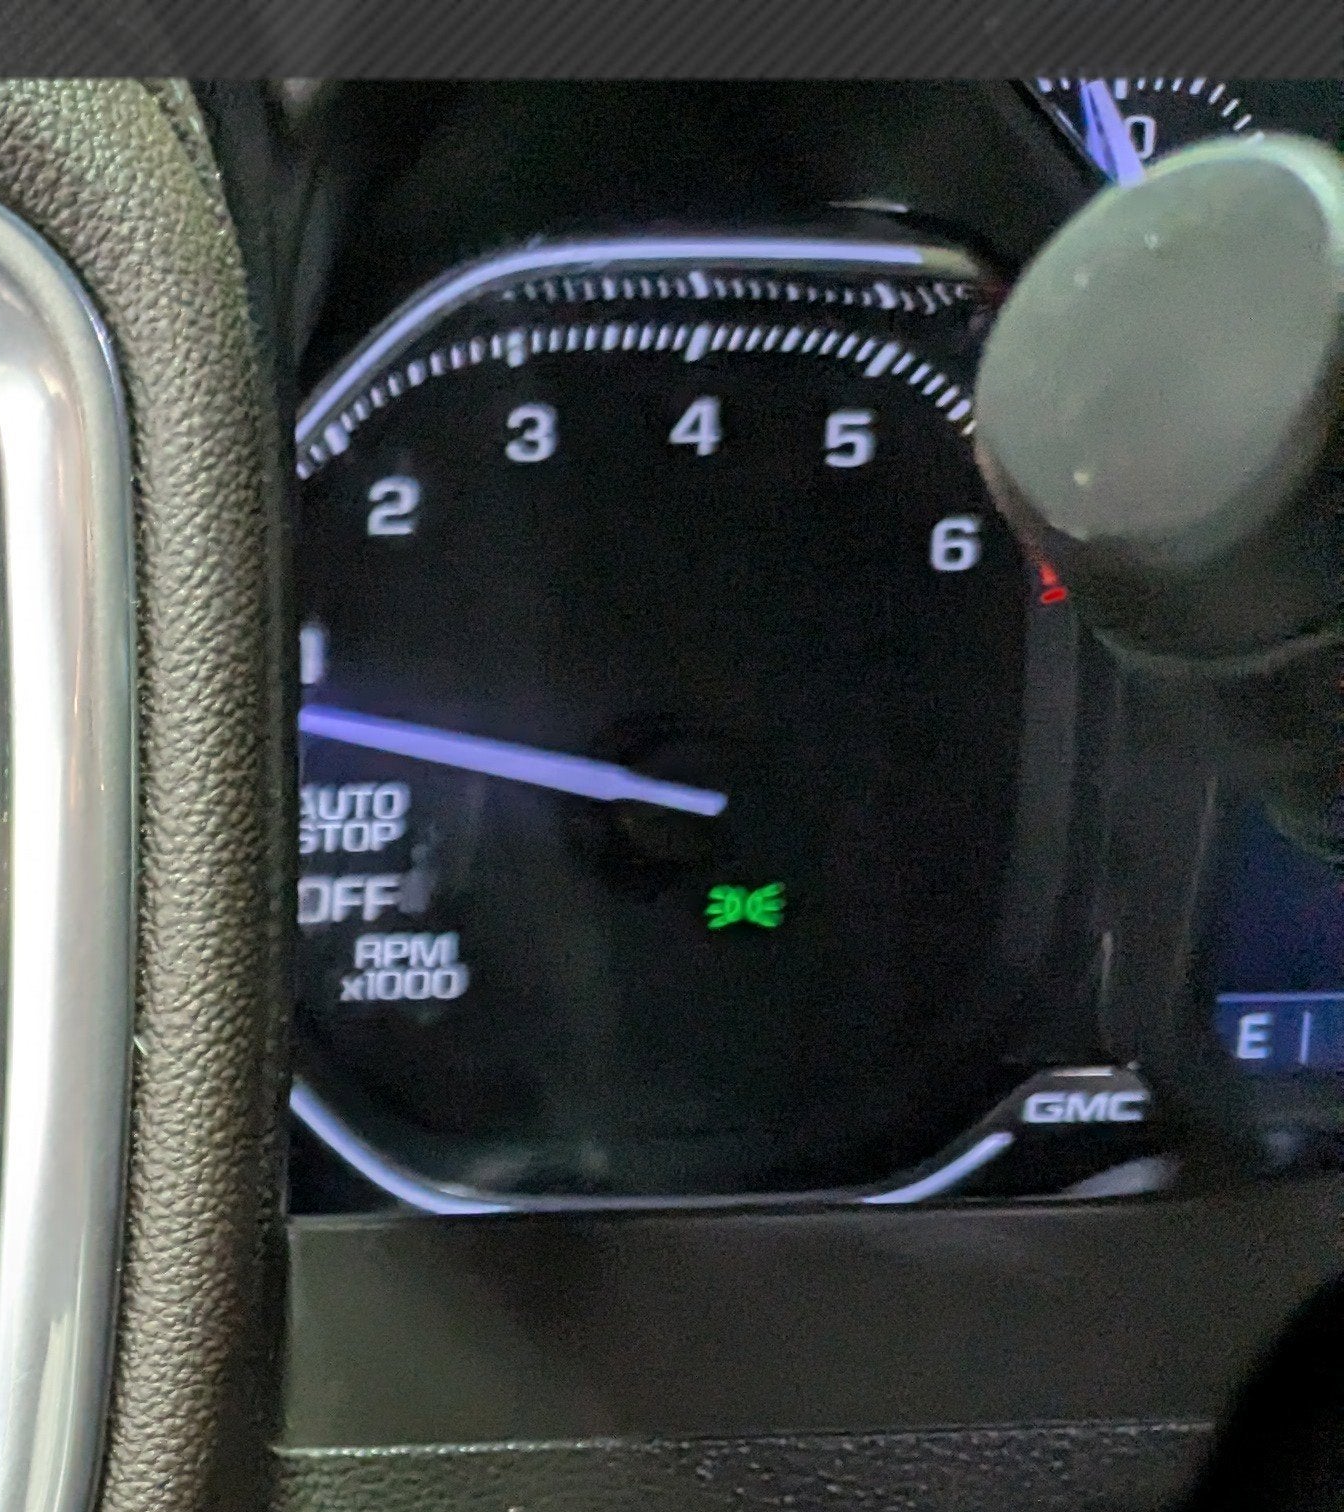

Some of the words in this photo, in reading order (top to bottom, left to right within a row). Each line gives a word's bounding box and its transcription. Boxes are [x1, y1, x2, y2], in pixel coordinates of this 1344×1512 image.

[505, 402, 556, 463] 3
[669, 396, 721, 456] 4
[824, 411, 874, 468] 5
[367, 476, 420, 536] 2
[930, 516, 978, 572] 6
[297, 876, 399, 923] OFF
[355, 934, 459, 969] RPM
[1236, 1012, 1273, 1059] E
[1022, 1091, 1150, 1123] GMC
